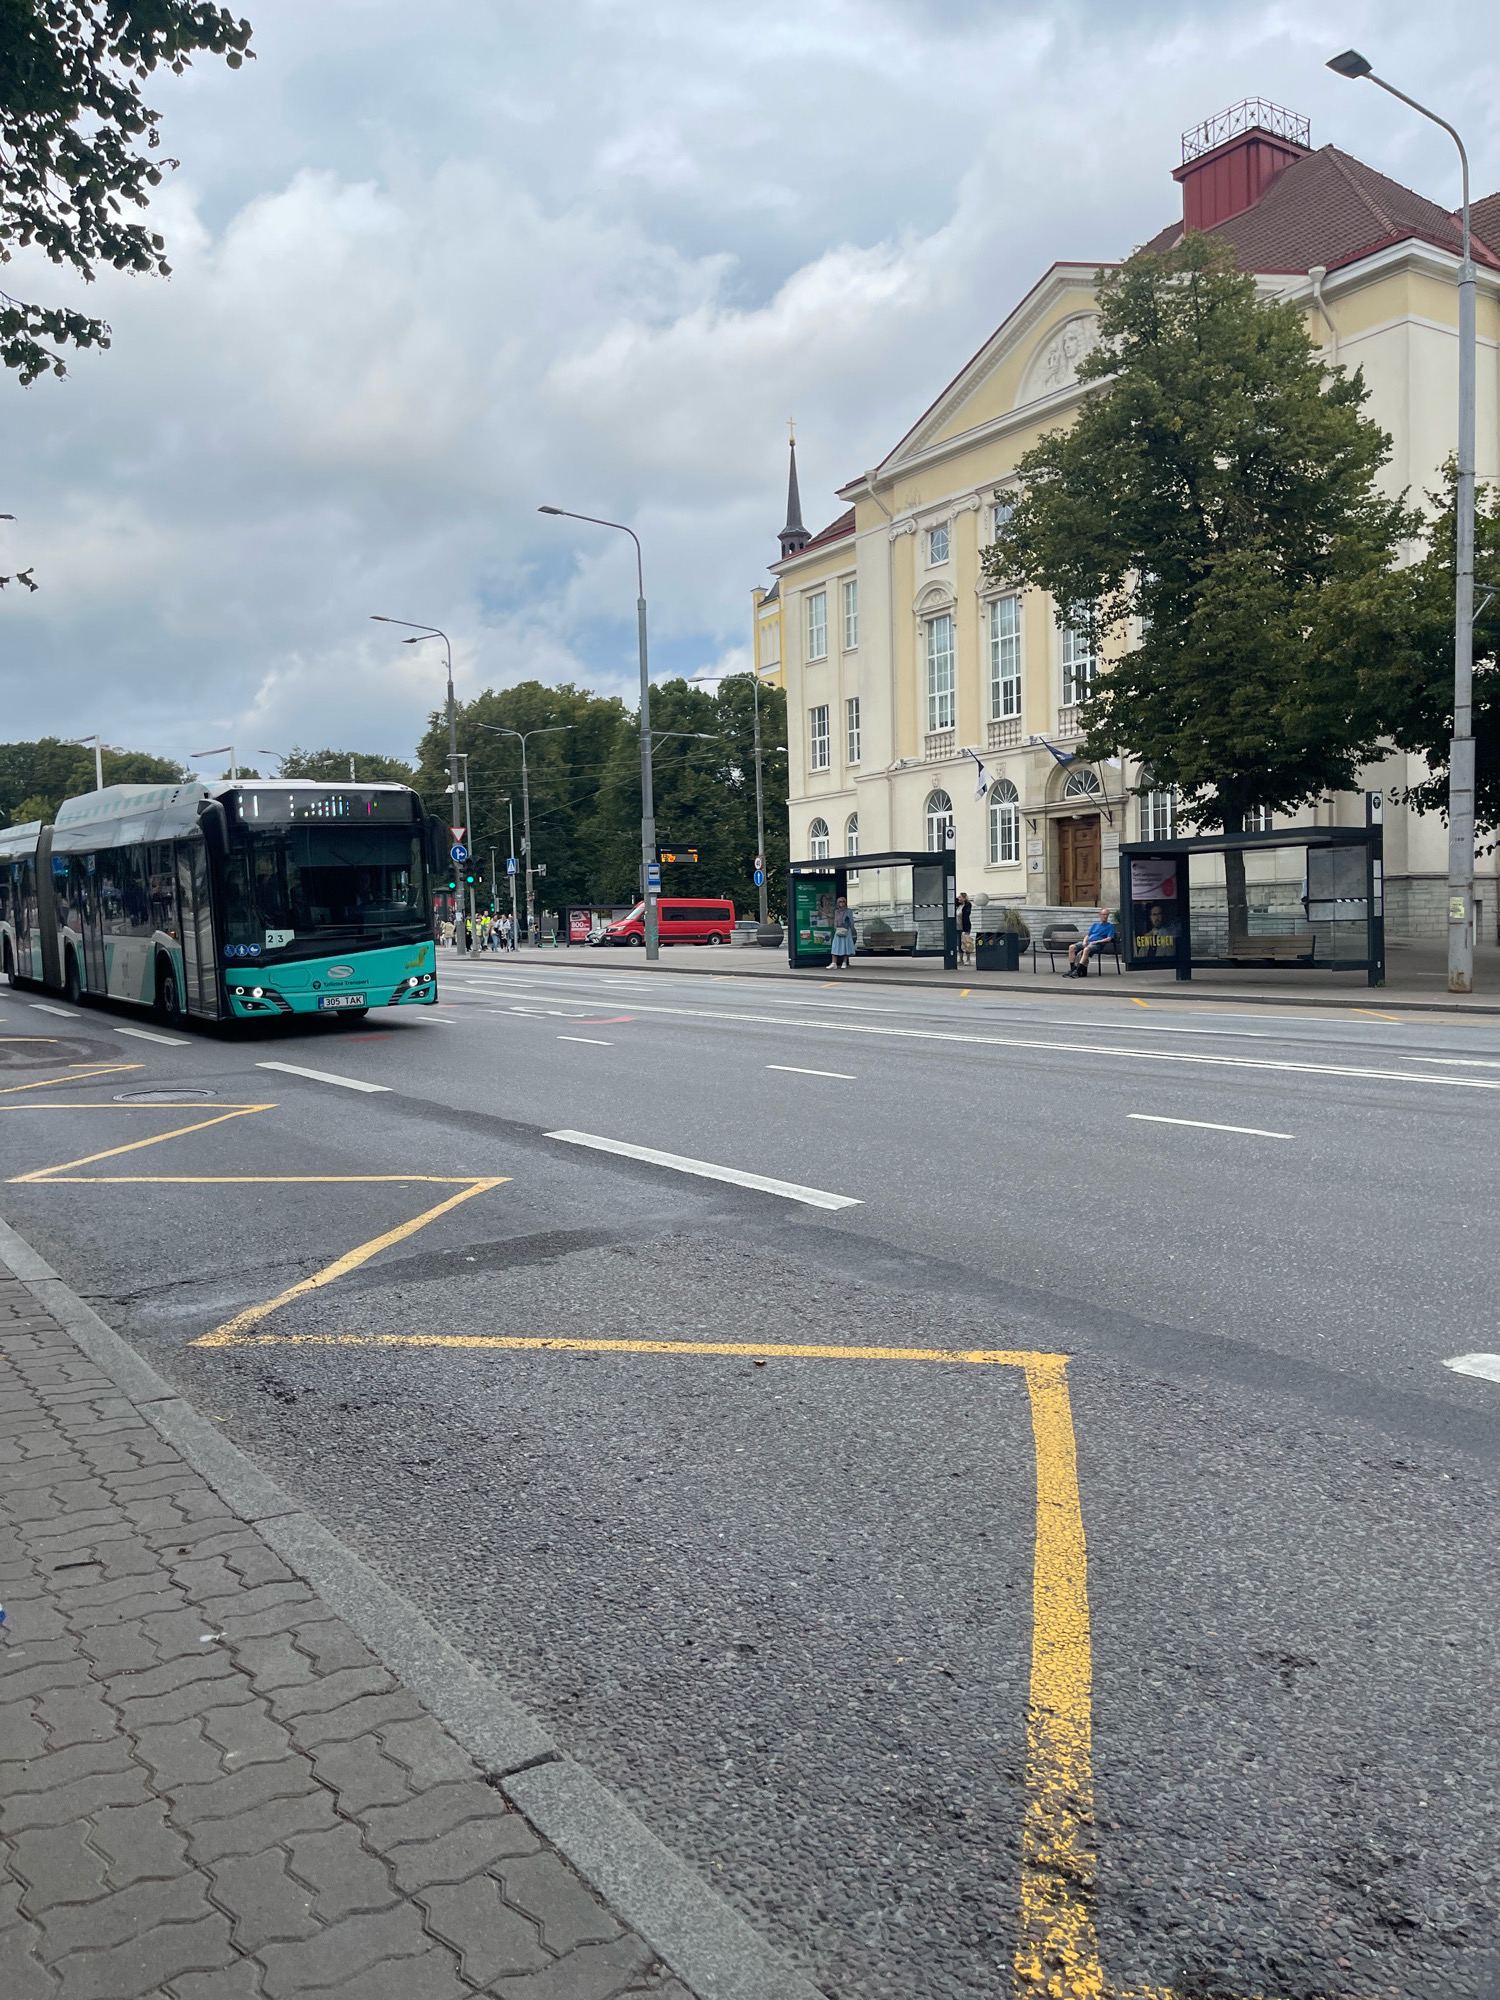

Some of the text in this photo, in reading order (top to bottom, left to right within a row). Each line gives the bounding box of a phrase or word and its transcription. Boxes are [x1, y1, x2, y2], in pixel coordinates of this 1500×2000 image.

[1136, 935, 1174, 948] GENTLEMEN
[325, 996, 362, 1006] 305 TAK
